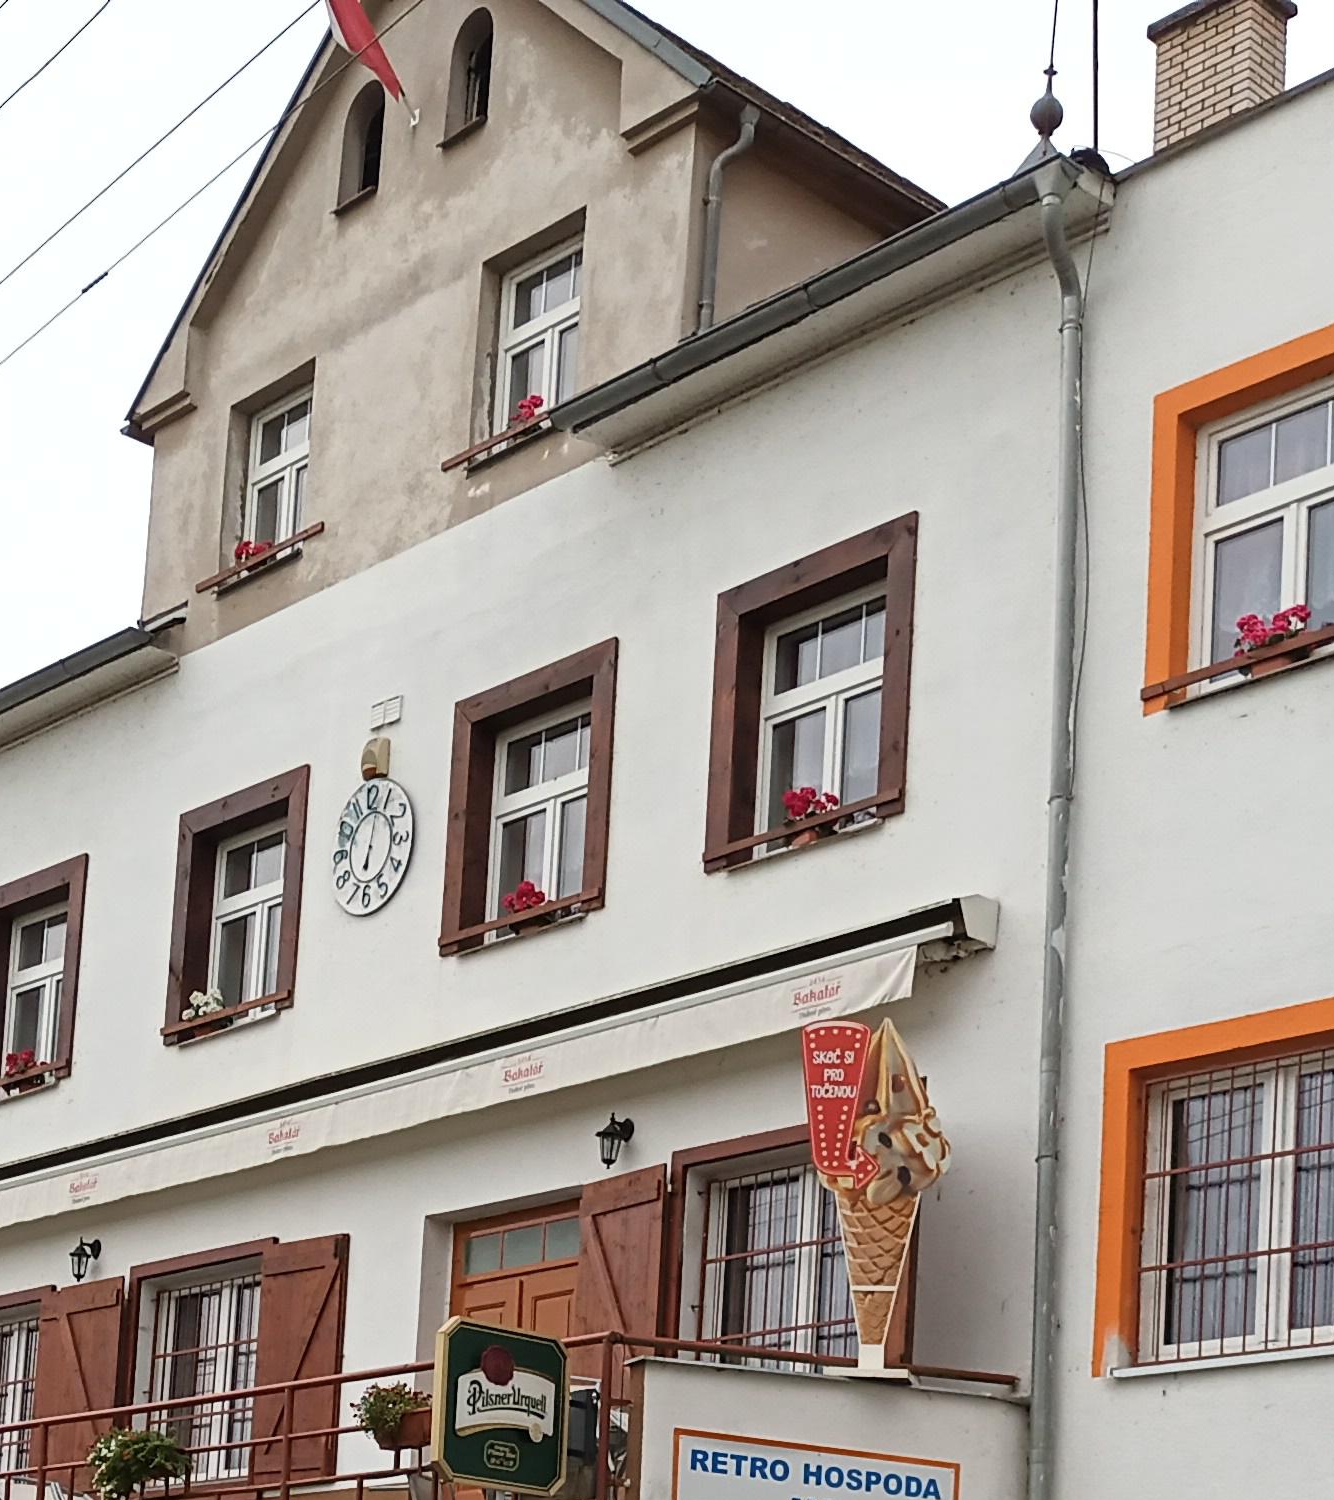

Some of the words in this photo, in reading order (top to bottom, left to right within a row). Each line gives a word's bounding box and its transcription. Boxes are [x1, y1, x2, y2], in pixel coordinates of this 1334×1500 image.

[383, 788, 392, 810] 1
[390, 803, 407, 827] 2
[393, 830, 409, 846] 3
[390, 856, 402, 872] 4
[336, 870, 350, 889] 8
[377, 873, 388, 899] 5
[346, 882, 361, 905] 7
[362, 884, 371, 908] 6
[812, 1048, 841, 1064] SKOČ
[844, 1051, 854, 1064] SI
[824, 1069, 844, 1081] PRO
[467, 1380, 513, 1415] Pilsner
[511, 1384, 547, 1416] Urquell
[690, 1449, 790, 1482] RETRO
[803, 1463, 942, 1500] HOSPODA
